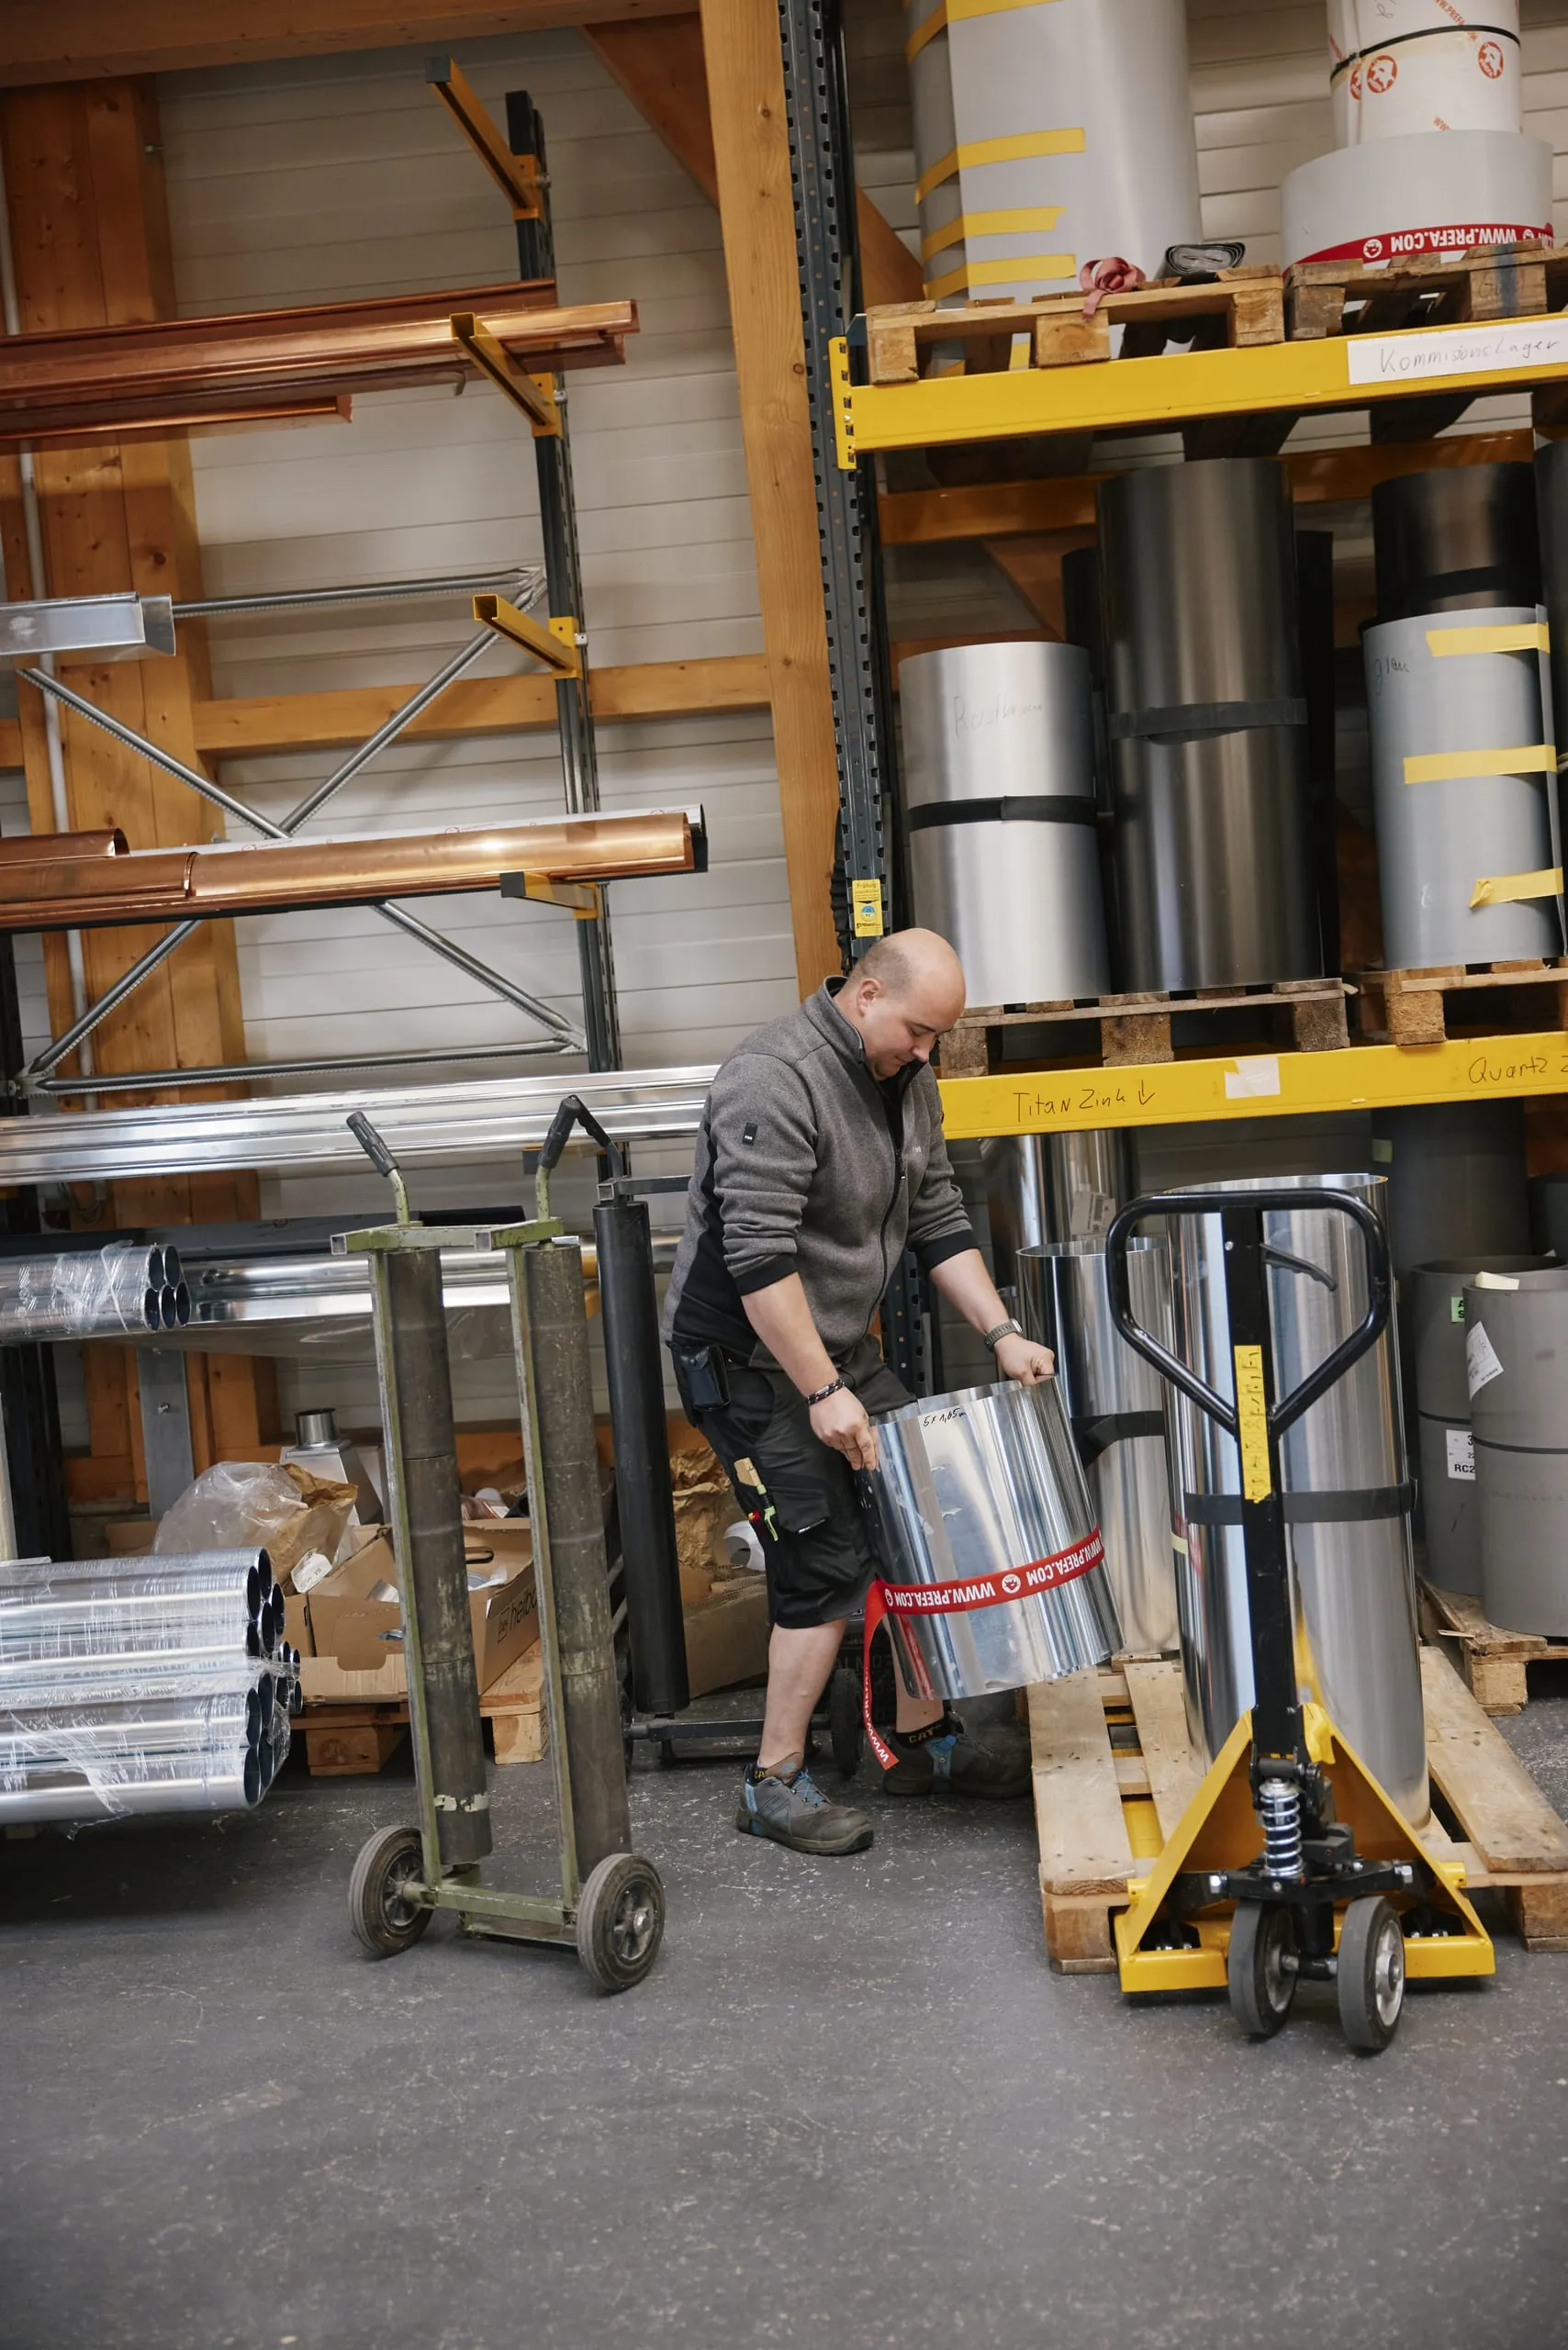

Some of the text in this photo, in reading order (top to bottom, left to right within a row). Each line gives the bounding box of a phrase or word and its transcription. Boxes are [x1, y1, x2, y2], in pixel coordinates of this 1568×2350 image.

[1391, 228, 1518, 252] WWW.PREFA.COM
[1025, 1536, 1103, 1586] WWW.PREFA.COM
[894, 1581, 996, 1607] WWW.PREFA.COM
